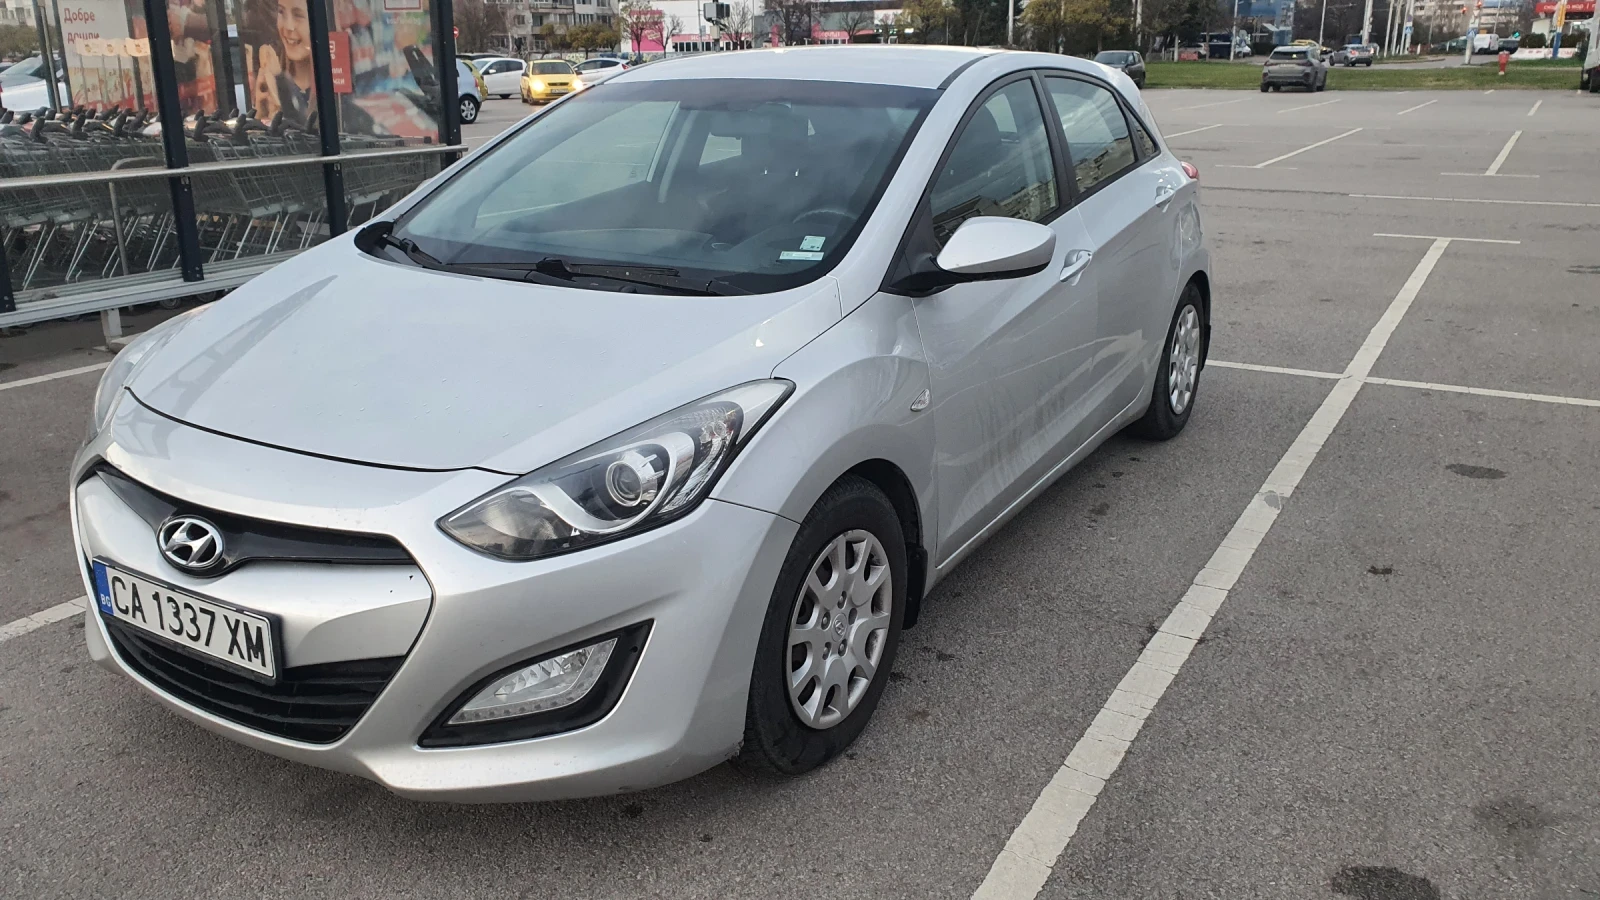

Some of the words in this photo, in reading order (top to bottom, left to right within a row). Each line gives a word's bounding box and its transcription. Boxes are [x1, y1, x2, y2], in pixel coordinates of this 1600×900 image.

[64, 7, 95, 24] Добре
[100, 593, 111, 608] BG
[111, 575, 147, 624] CA
[152, 590, 217, 647] 1337
[222, 613, 267, 668] XM
